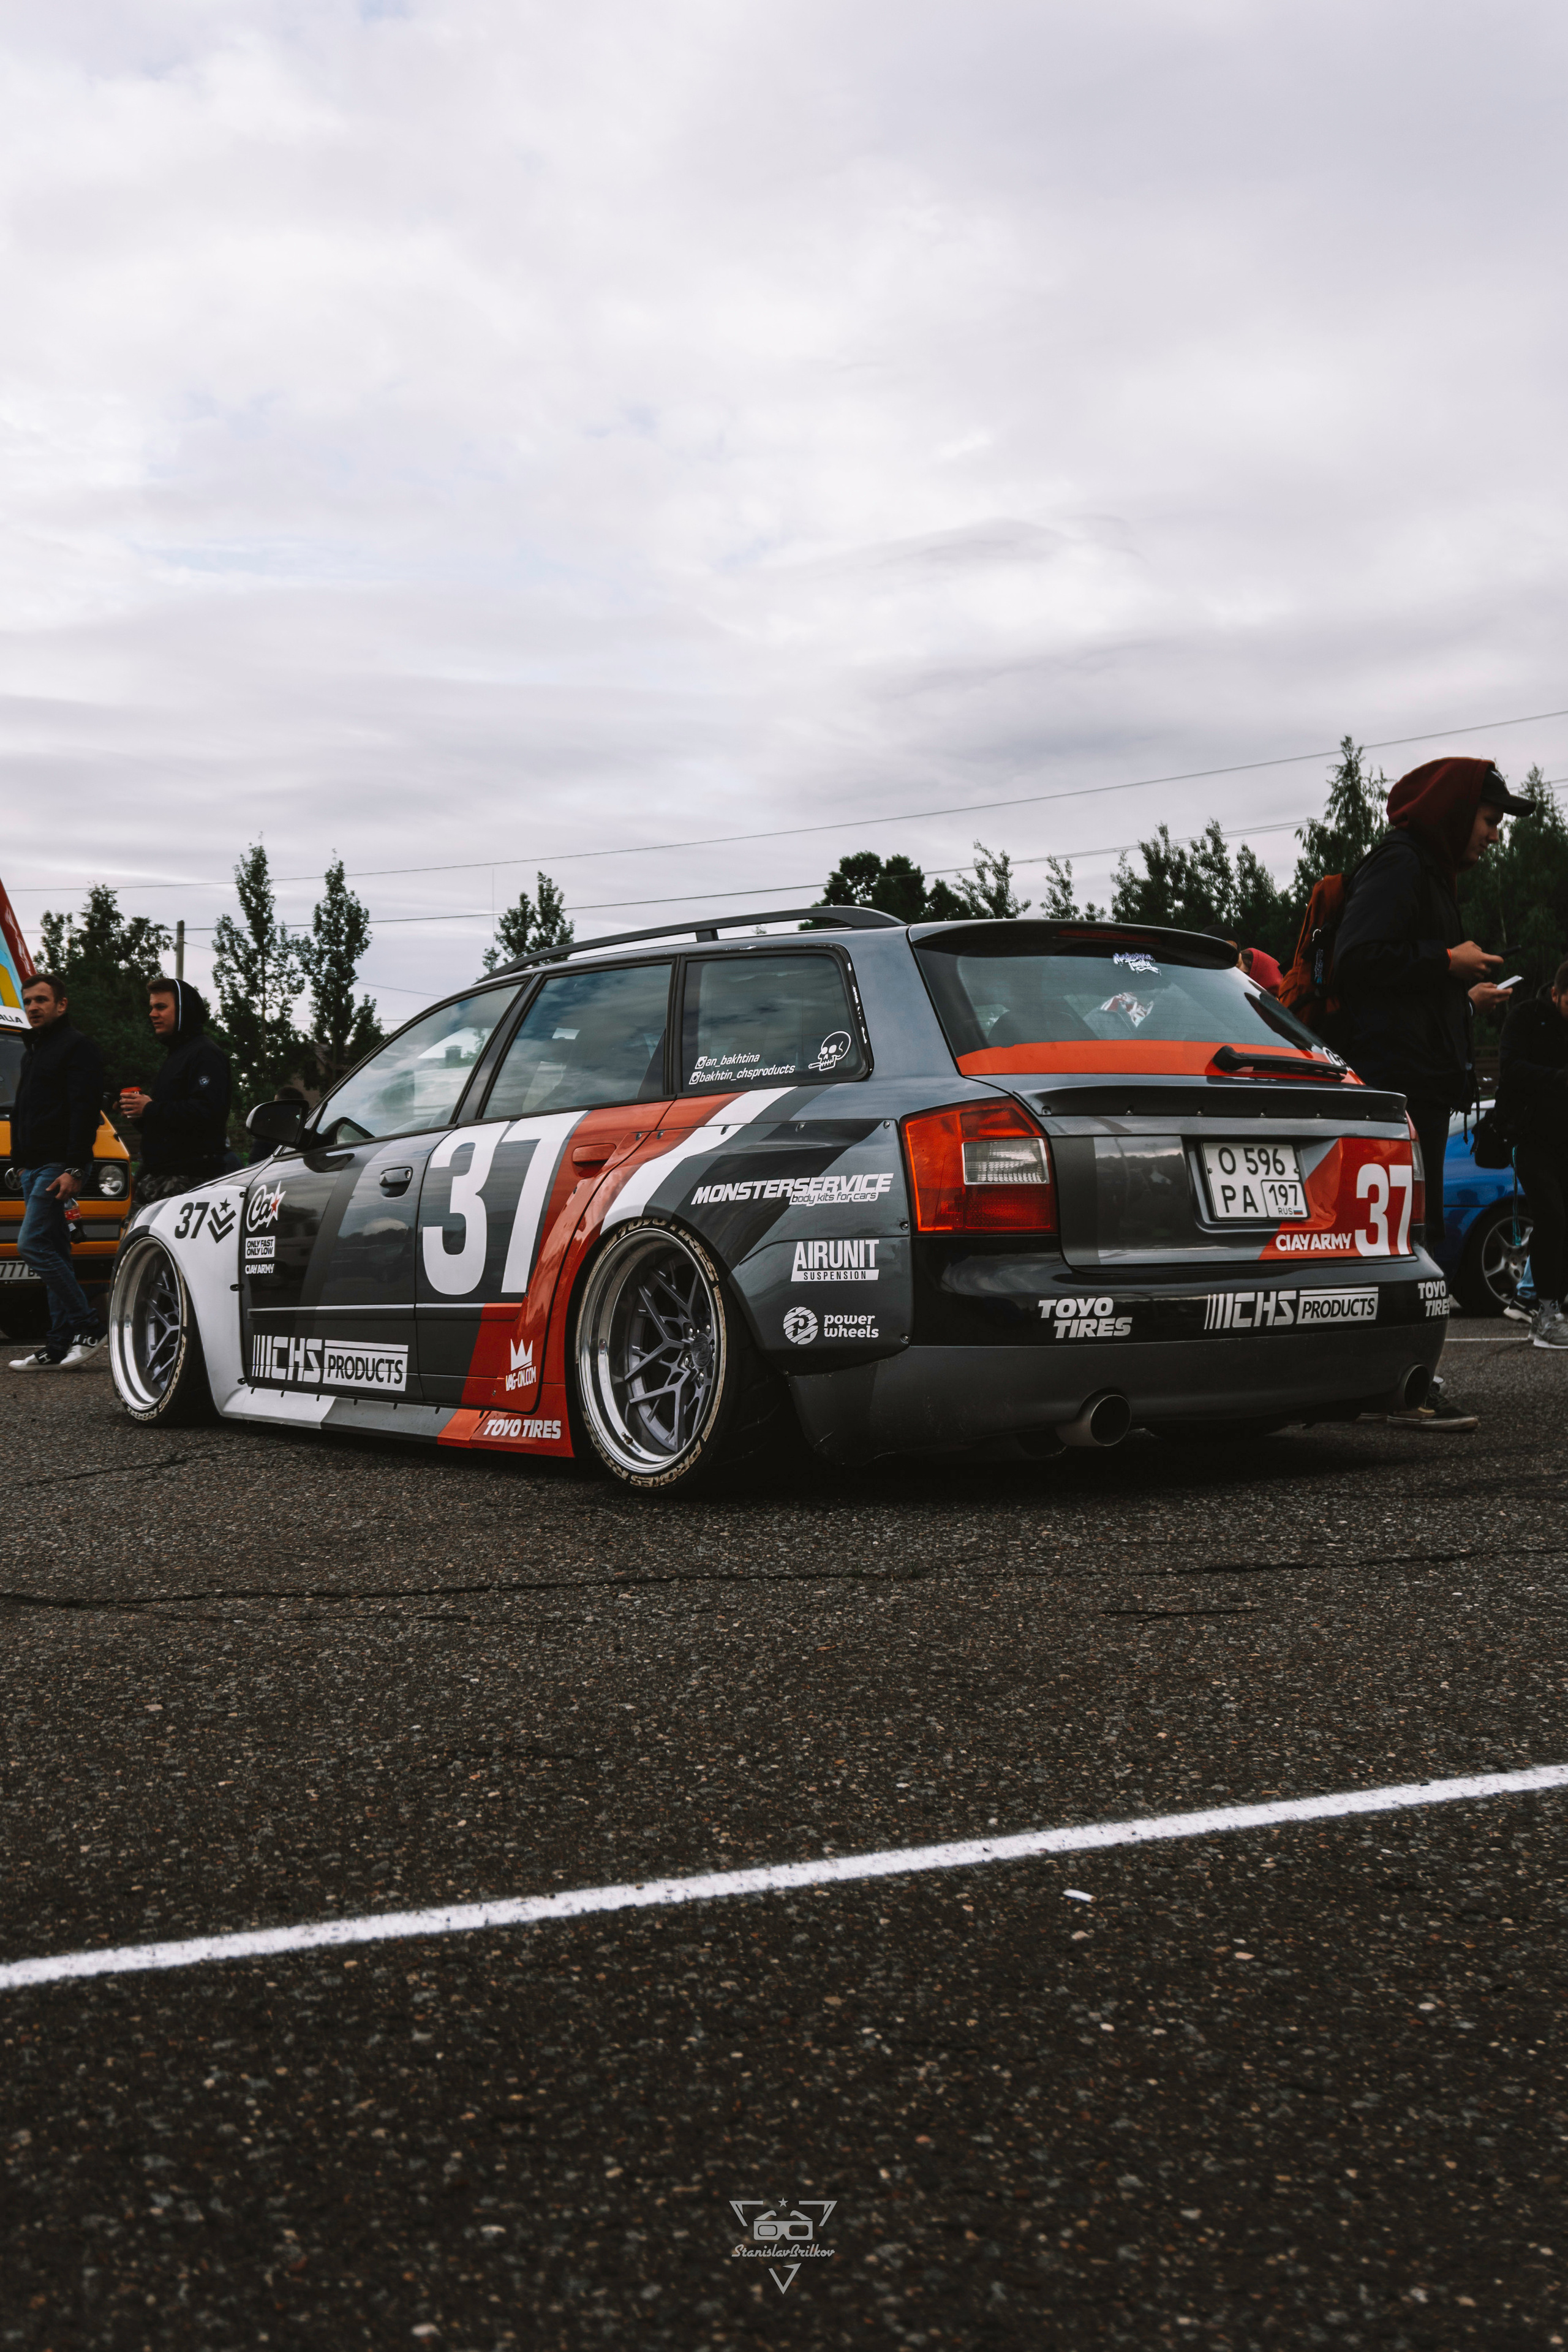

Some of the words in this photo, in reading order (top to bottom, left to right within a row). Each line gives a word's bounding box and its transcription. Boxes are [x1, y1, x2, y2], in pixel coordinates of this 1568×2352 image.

[705, 1053, 761, 1067] an_bakhtina
[699, 1065, 796, 1082] bakhtin_chsproducts
[1243, 1147, 1286, 1175] 596
[691, 1173, 894, 1205] MONSTERSERVICE
[792, 1192, 815, 1204] body
[817, 1192, 834, 1201] kits
[837, 1191, 852, 1200] for
[853, 1191, 876, 1200] cars
[1268, 1184, 1297, 1206] 197
[423, 1110, 589, 1295] 37
[1355, 1163, 1413, 1257] 37
[175, 1202, 210, 1239] 37
[794, 1240, 880, 1269] AIRUNIT
[804, 1271, 867, 1280] SUSPENSION
[1418, 1280, 1446, 1299] TOYO
[1038, 1297, 1114, 1318] TOYO
[1232, 1290, 1297, 1328] CHS
[1302, 1297, 1376, 1319] PRODUCTS
[824, 1314, 876, 1327] power
[824, 1325, 880, 1338] wheels
[1053, 1317, 1133, 1339] TIRES
[271, 1336, 323, 1383] CHS
[327, 1354, 404, 1384] PRODUCTS
[505, 1366, 537, 1392] VAG-ON.COM
[483, 1419, 522, 1438] TOYO
[522, 1419, 562, 1439] TIRES
[630, 1440, 702, 1488] PROXES
